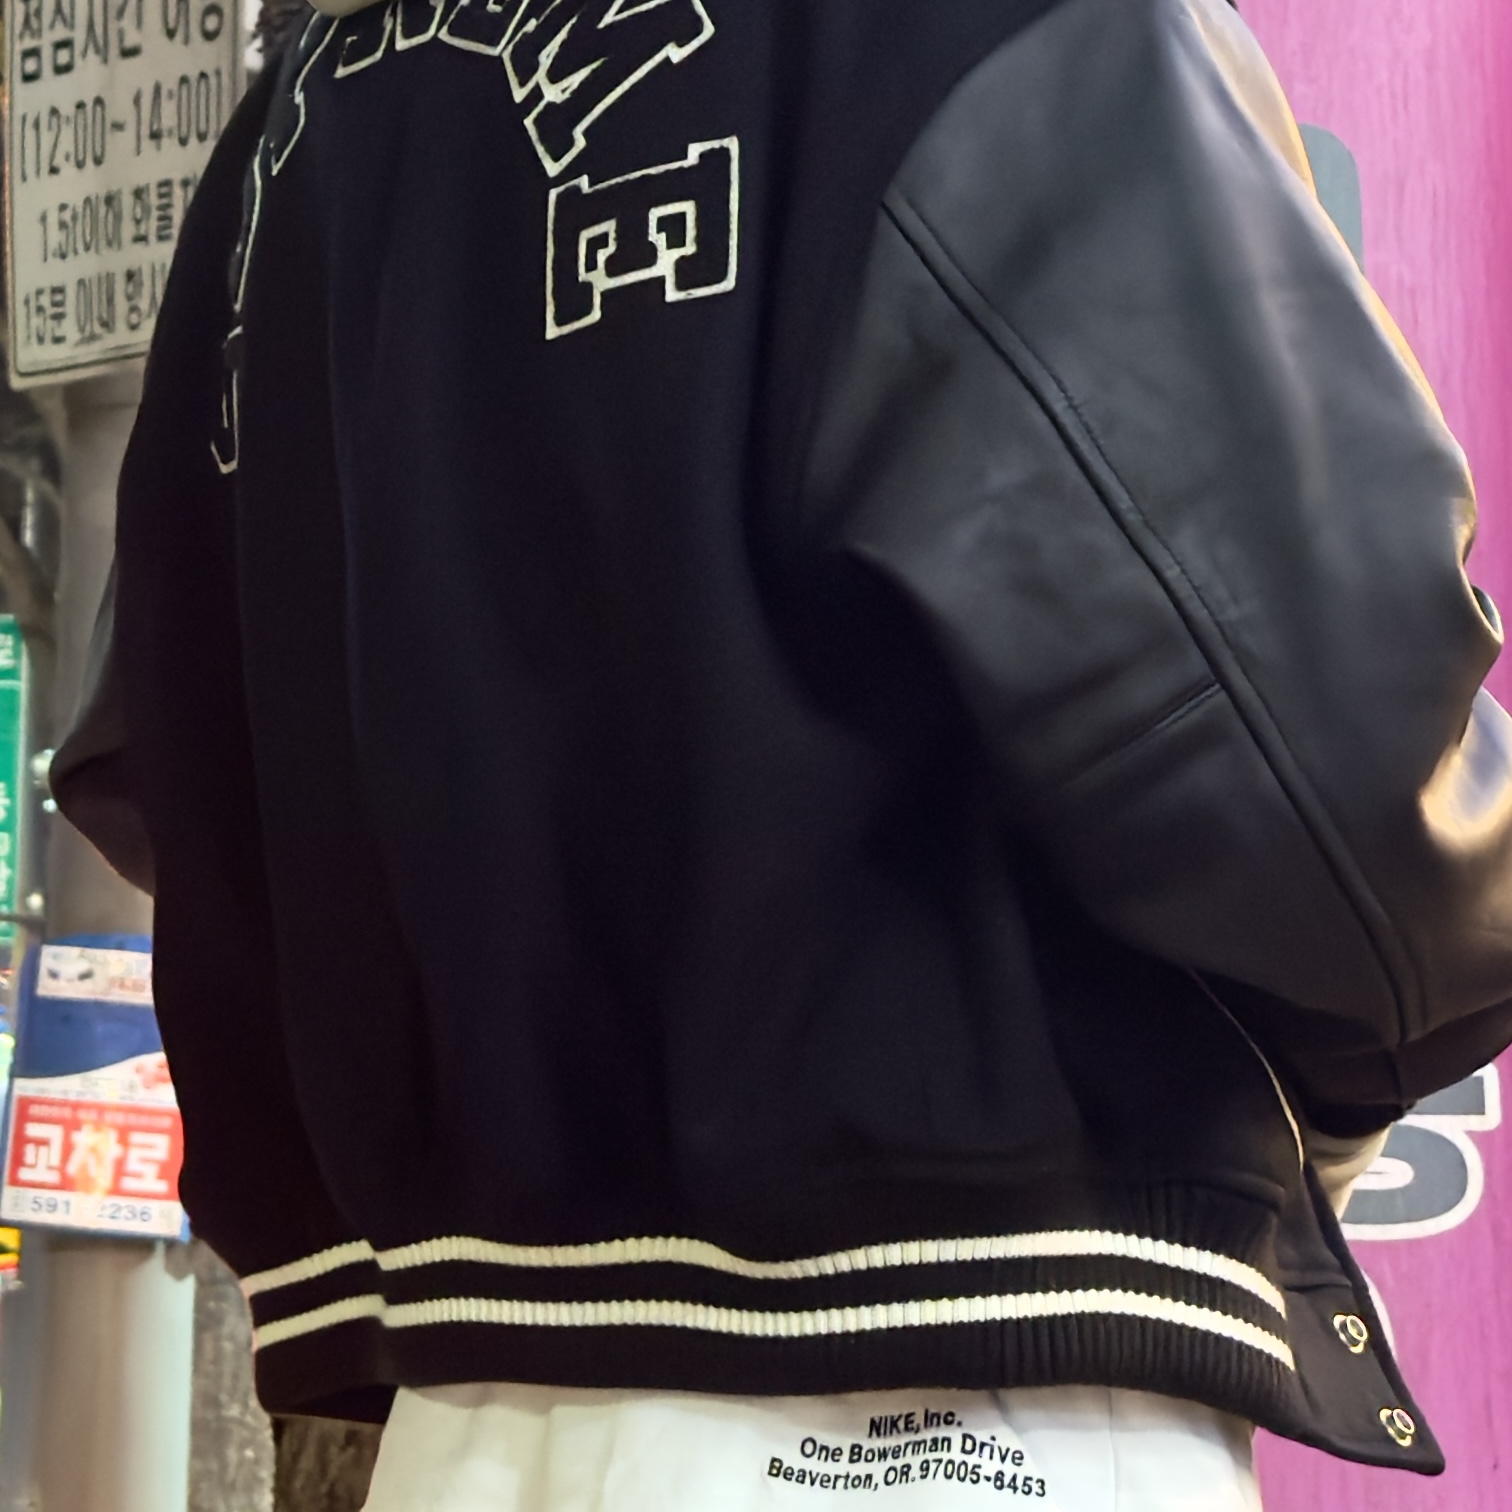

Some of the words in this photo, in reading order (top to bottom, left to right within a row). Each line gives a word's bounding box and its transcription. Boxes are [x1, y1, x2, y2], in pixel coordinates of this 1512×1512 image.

[17, 1121, 171, 1194] 교차로
[800, 1437, 843, 1463] One
[848, 1436, 952, 1464] Bowerman
[960, 1433, 1025, 1466] Drive
[767, 1457, 879, 1491] Beaverton,
[919, 1458, 1047, 1498] 97005-6453
